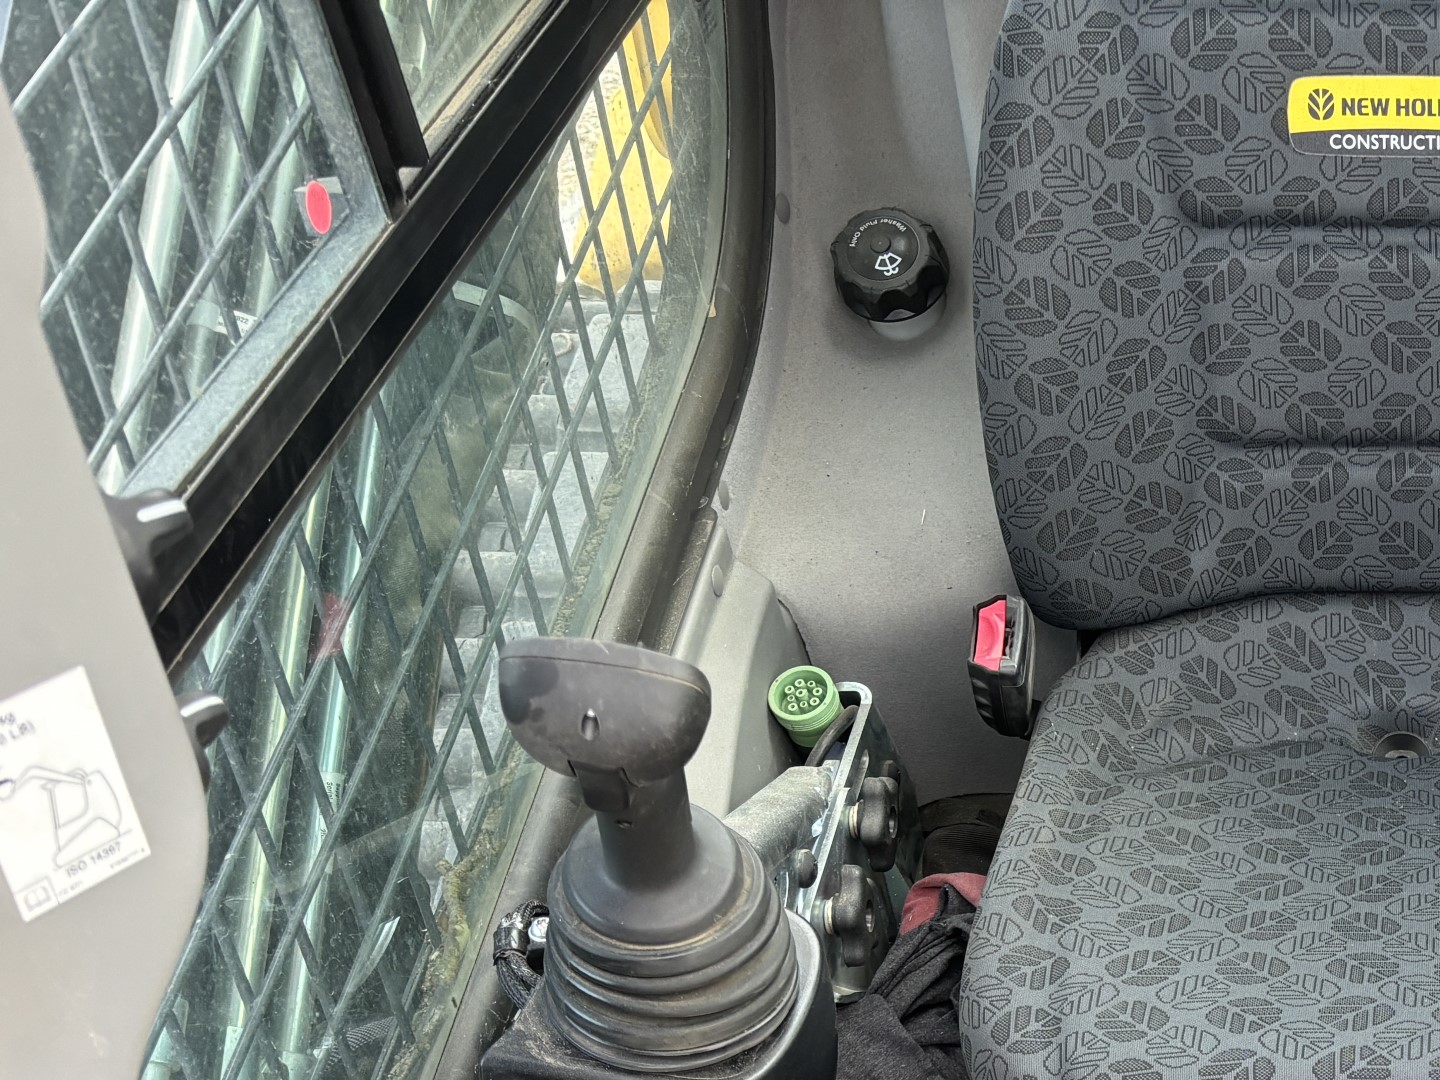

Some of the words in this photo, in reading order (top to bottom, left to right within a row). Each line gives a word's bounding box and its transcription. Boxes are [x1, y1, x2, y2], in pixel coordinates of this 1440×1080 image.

[1341, 97, 1390, 116] NEW
[860, 219, 878, 231] Fluid
[880, 219, 907, 232] Washer
[849, 231, 861, 247] Only
[66, 859, 88, 879] ISO
